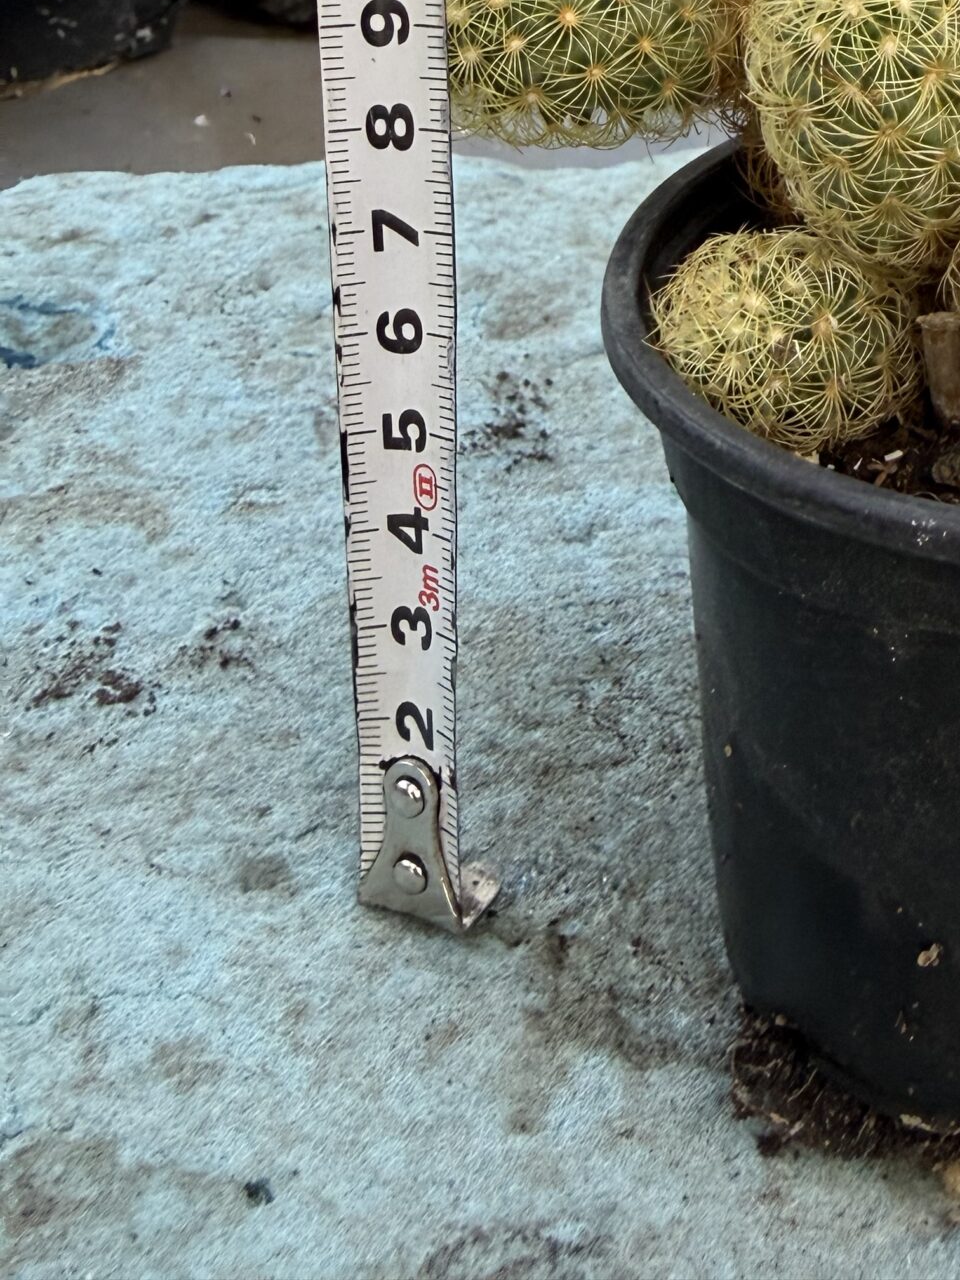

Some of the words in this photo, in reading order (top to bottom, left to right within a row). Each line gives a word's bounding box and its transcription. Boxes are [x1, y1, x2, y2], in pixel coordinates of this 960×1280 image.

[365, 102, 415, 152] 8
[371, 208, 419, 253] 7
[376, 307, 423, 355] 6
[383, 408, 427, 454] 5
[387, 507, 429, 555] 4
[418, 564, 440, 611] 3m
[390, 605, 432, 651] 3
[395, 700, 434, 751] 2
